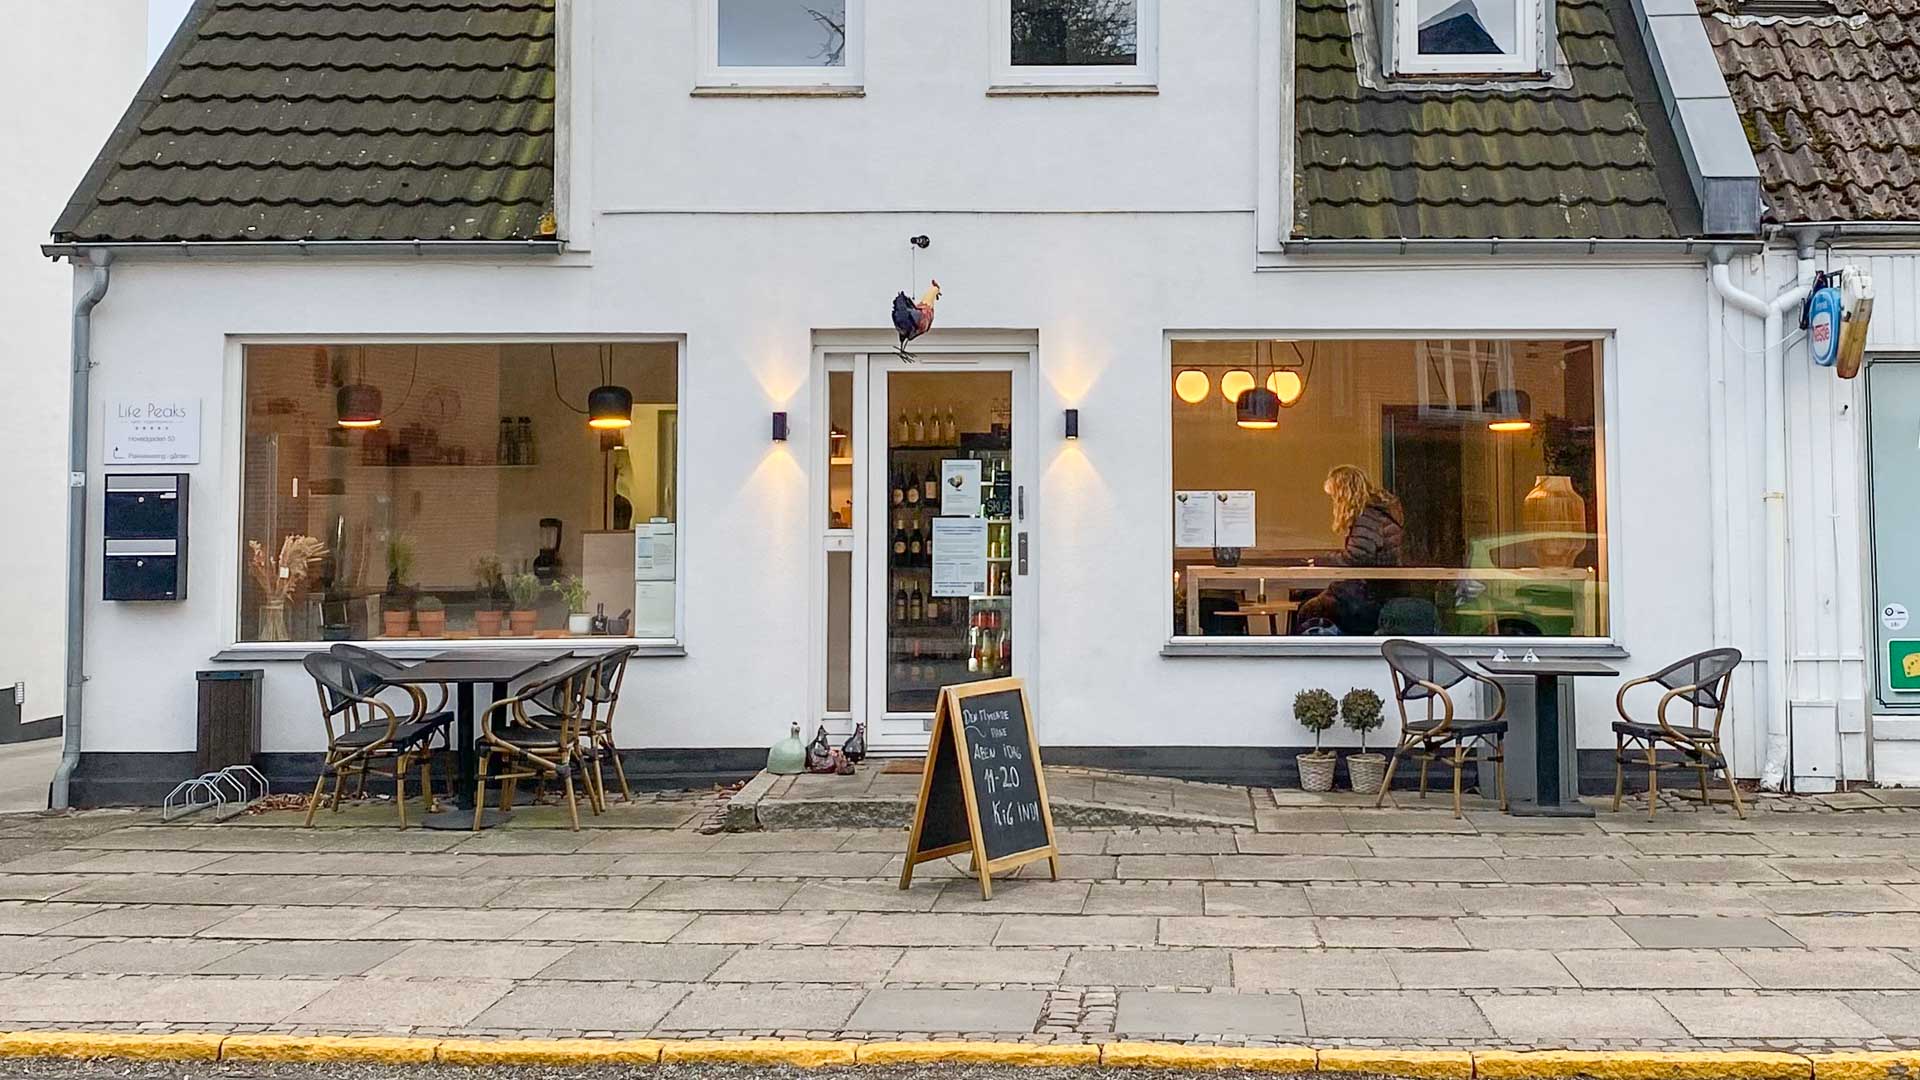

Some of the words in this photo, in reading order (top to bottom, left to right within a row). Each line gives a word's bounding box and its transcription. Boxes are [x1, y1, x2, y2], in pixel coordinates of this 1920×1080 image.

[118, 403, 141, 418] Life
[147, 402, 187, 418] Peaks
[984, 766, 1020, 793] 11-20
